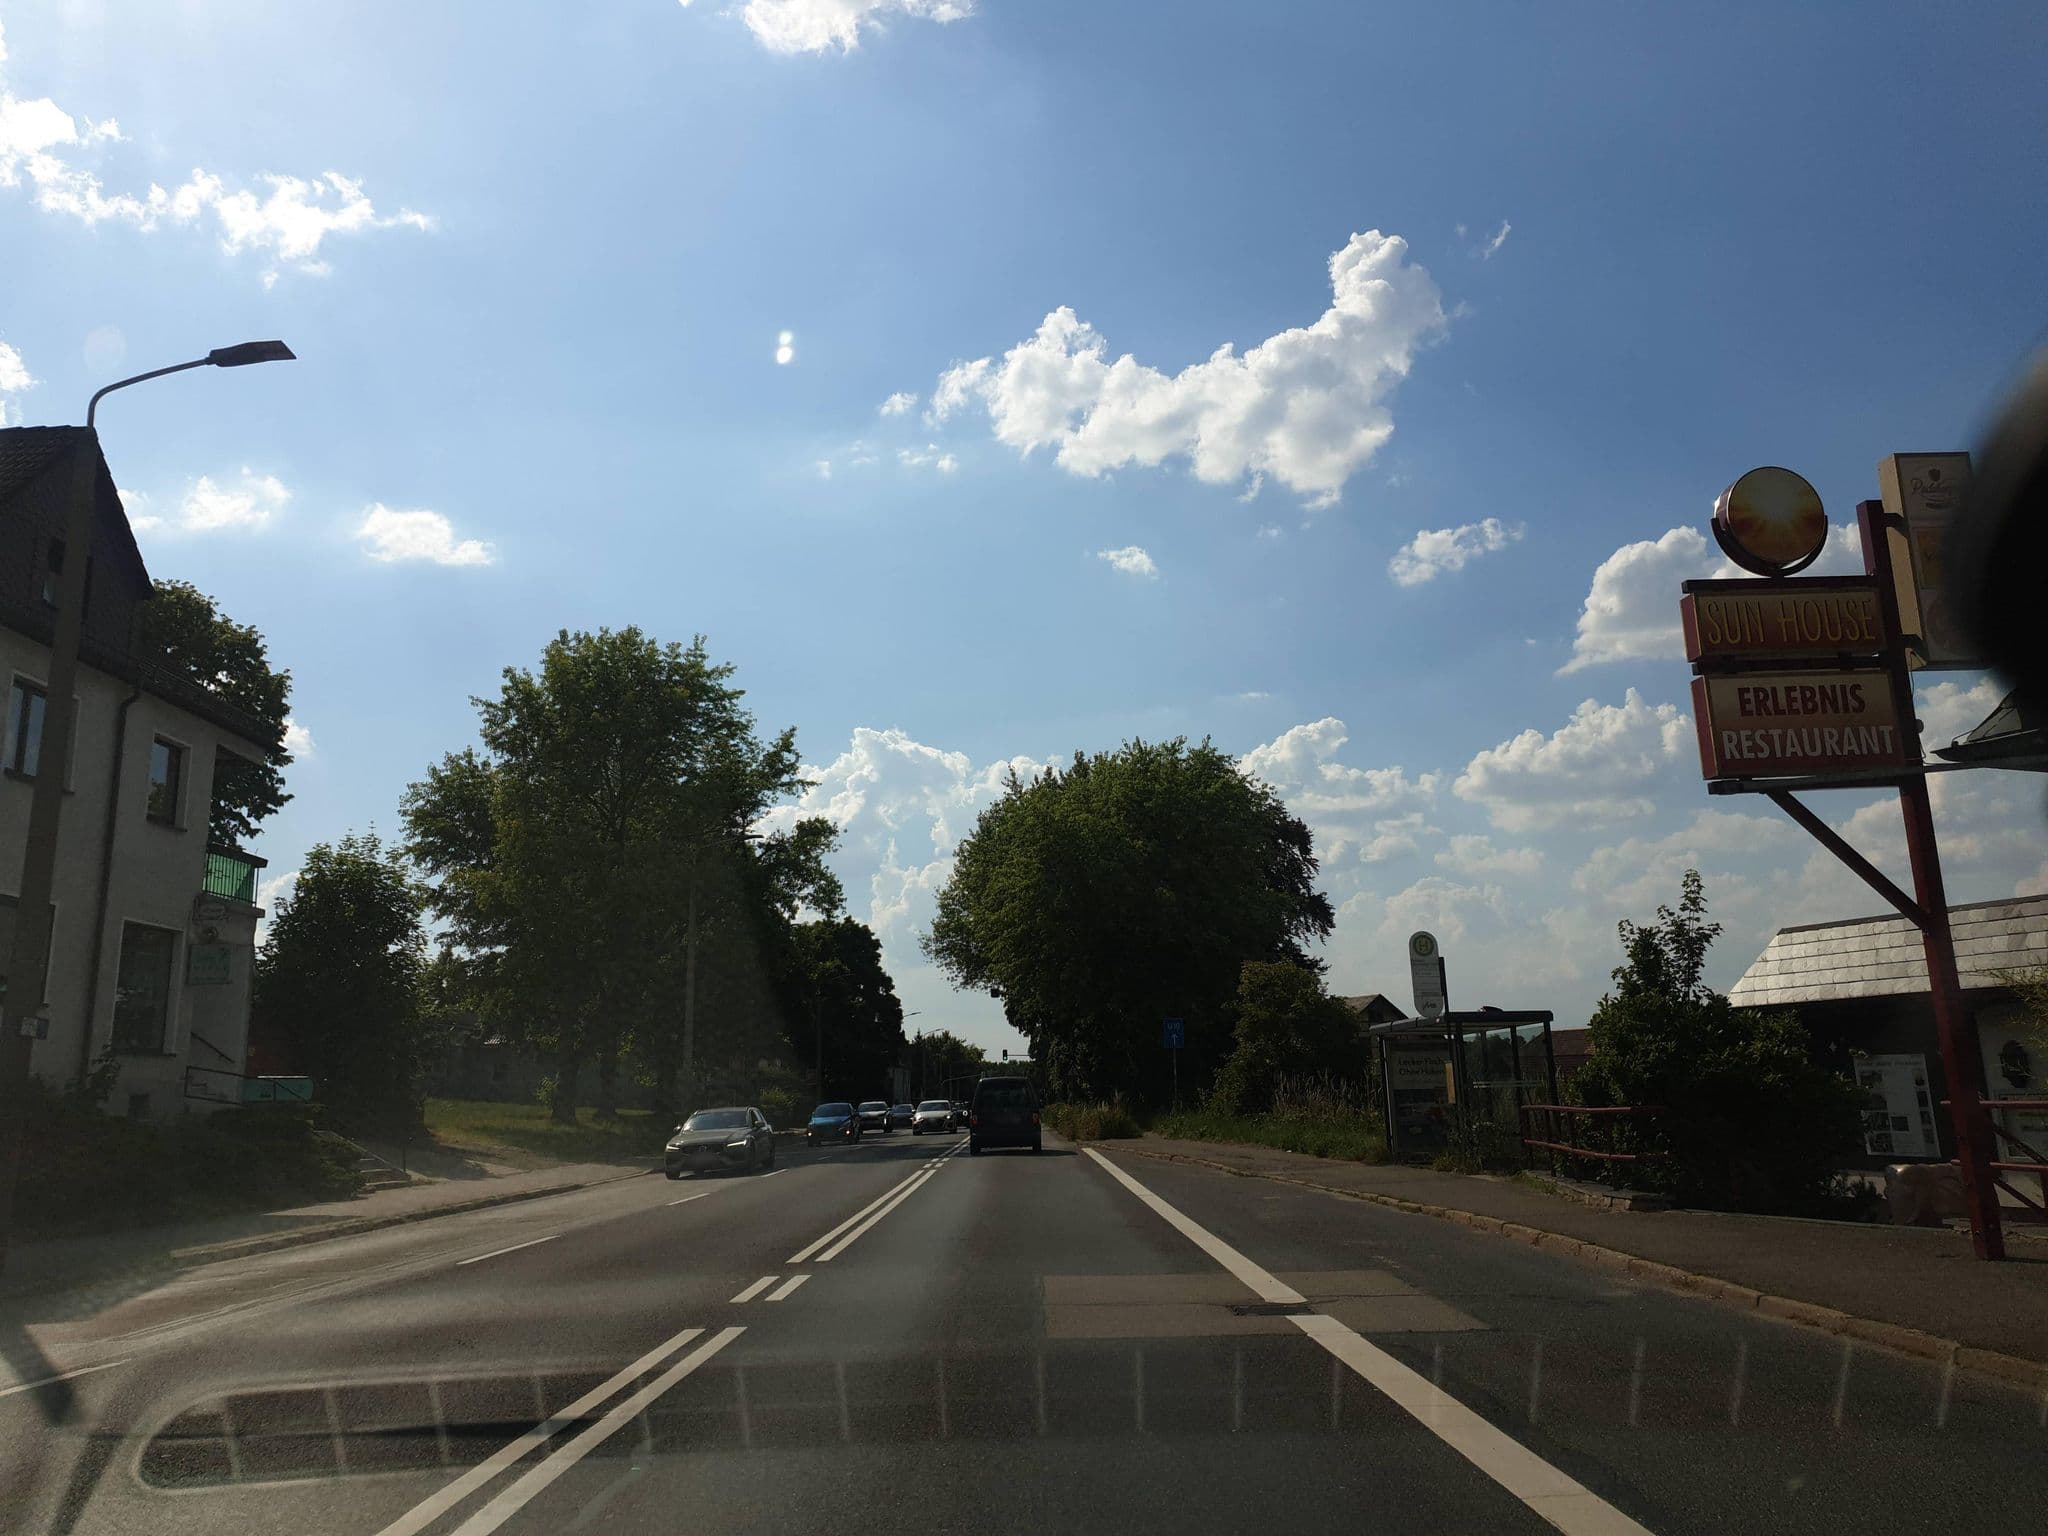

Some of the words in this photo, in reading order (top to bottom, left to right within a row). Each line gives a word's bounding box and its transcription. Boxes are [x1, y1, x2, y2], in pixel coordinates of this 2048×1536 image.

[1706, 599, 1764, 644] SUN
[1776, 598, 1876, 642] HOUSE
[1737, 683, 1866, 717] ERLEBNIS
[1722, 725, 1893, 760] RESTAURANT
